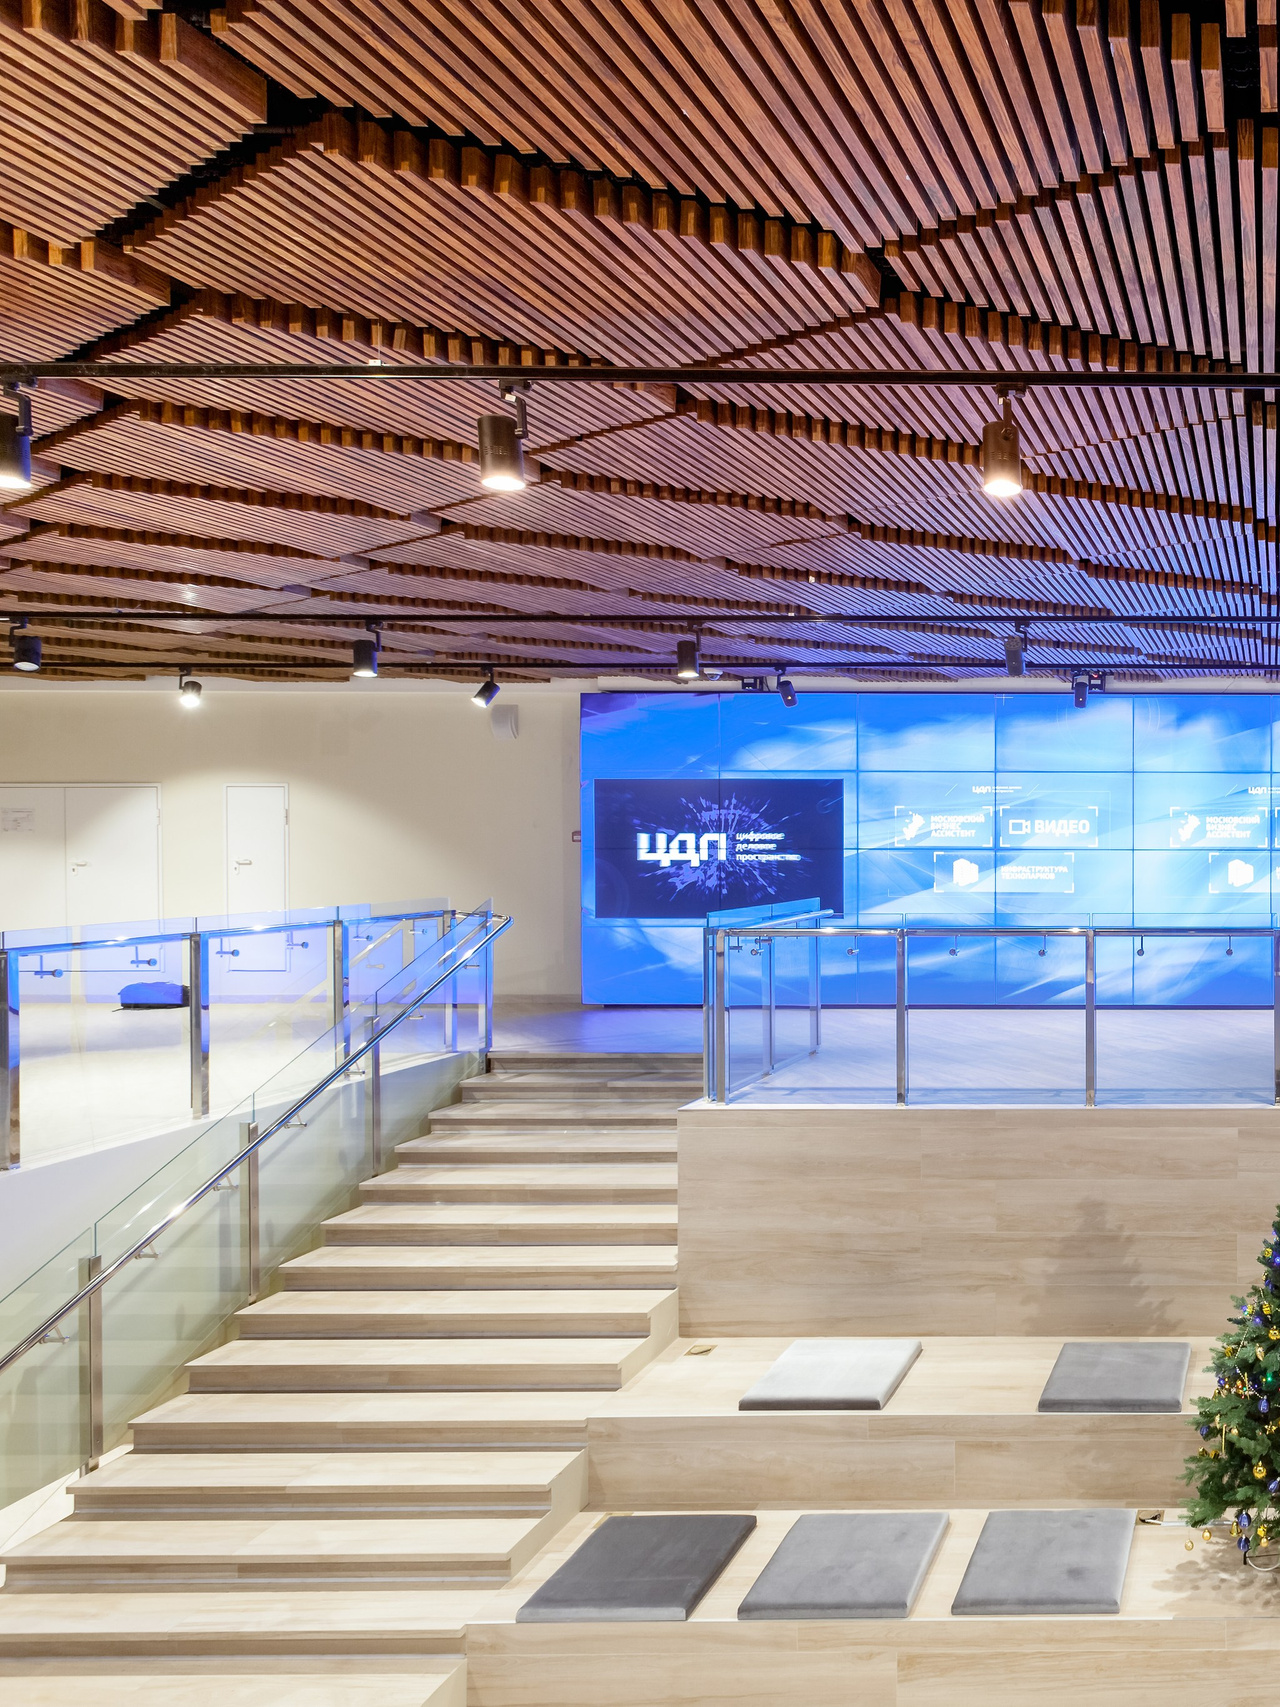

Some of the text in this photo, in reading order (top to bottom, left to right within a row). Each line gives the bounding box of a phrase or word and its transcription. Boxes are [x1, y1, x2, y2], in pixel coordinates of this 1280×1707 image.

[931, 814, 985, 823] МОСКОВСКИЙ
[1206, 815, 1260, 824] МОСКОВСКИЙ
[1035, 820, 1090, 837] ВИДЕО
[637, 832, 727, 867] ЦДП
